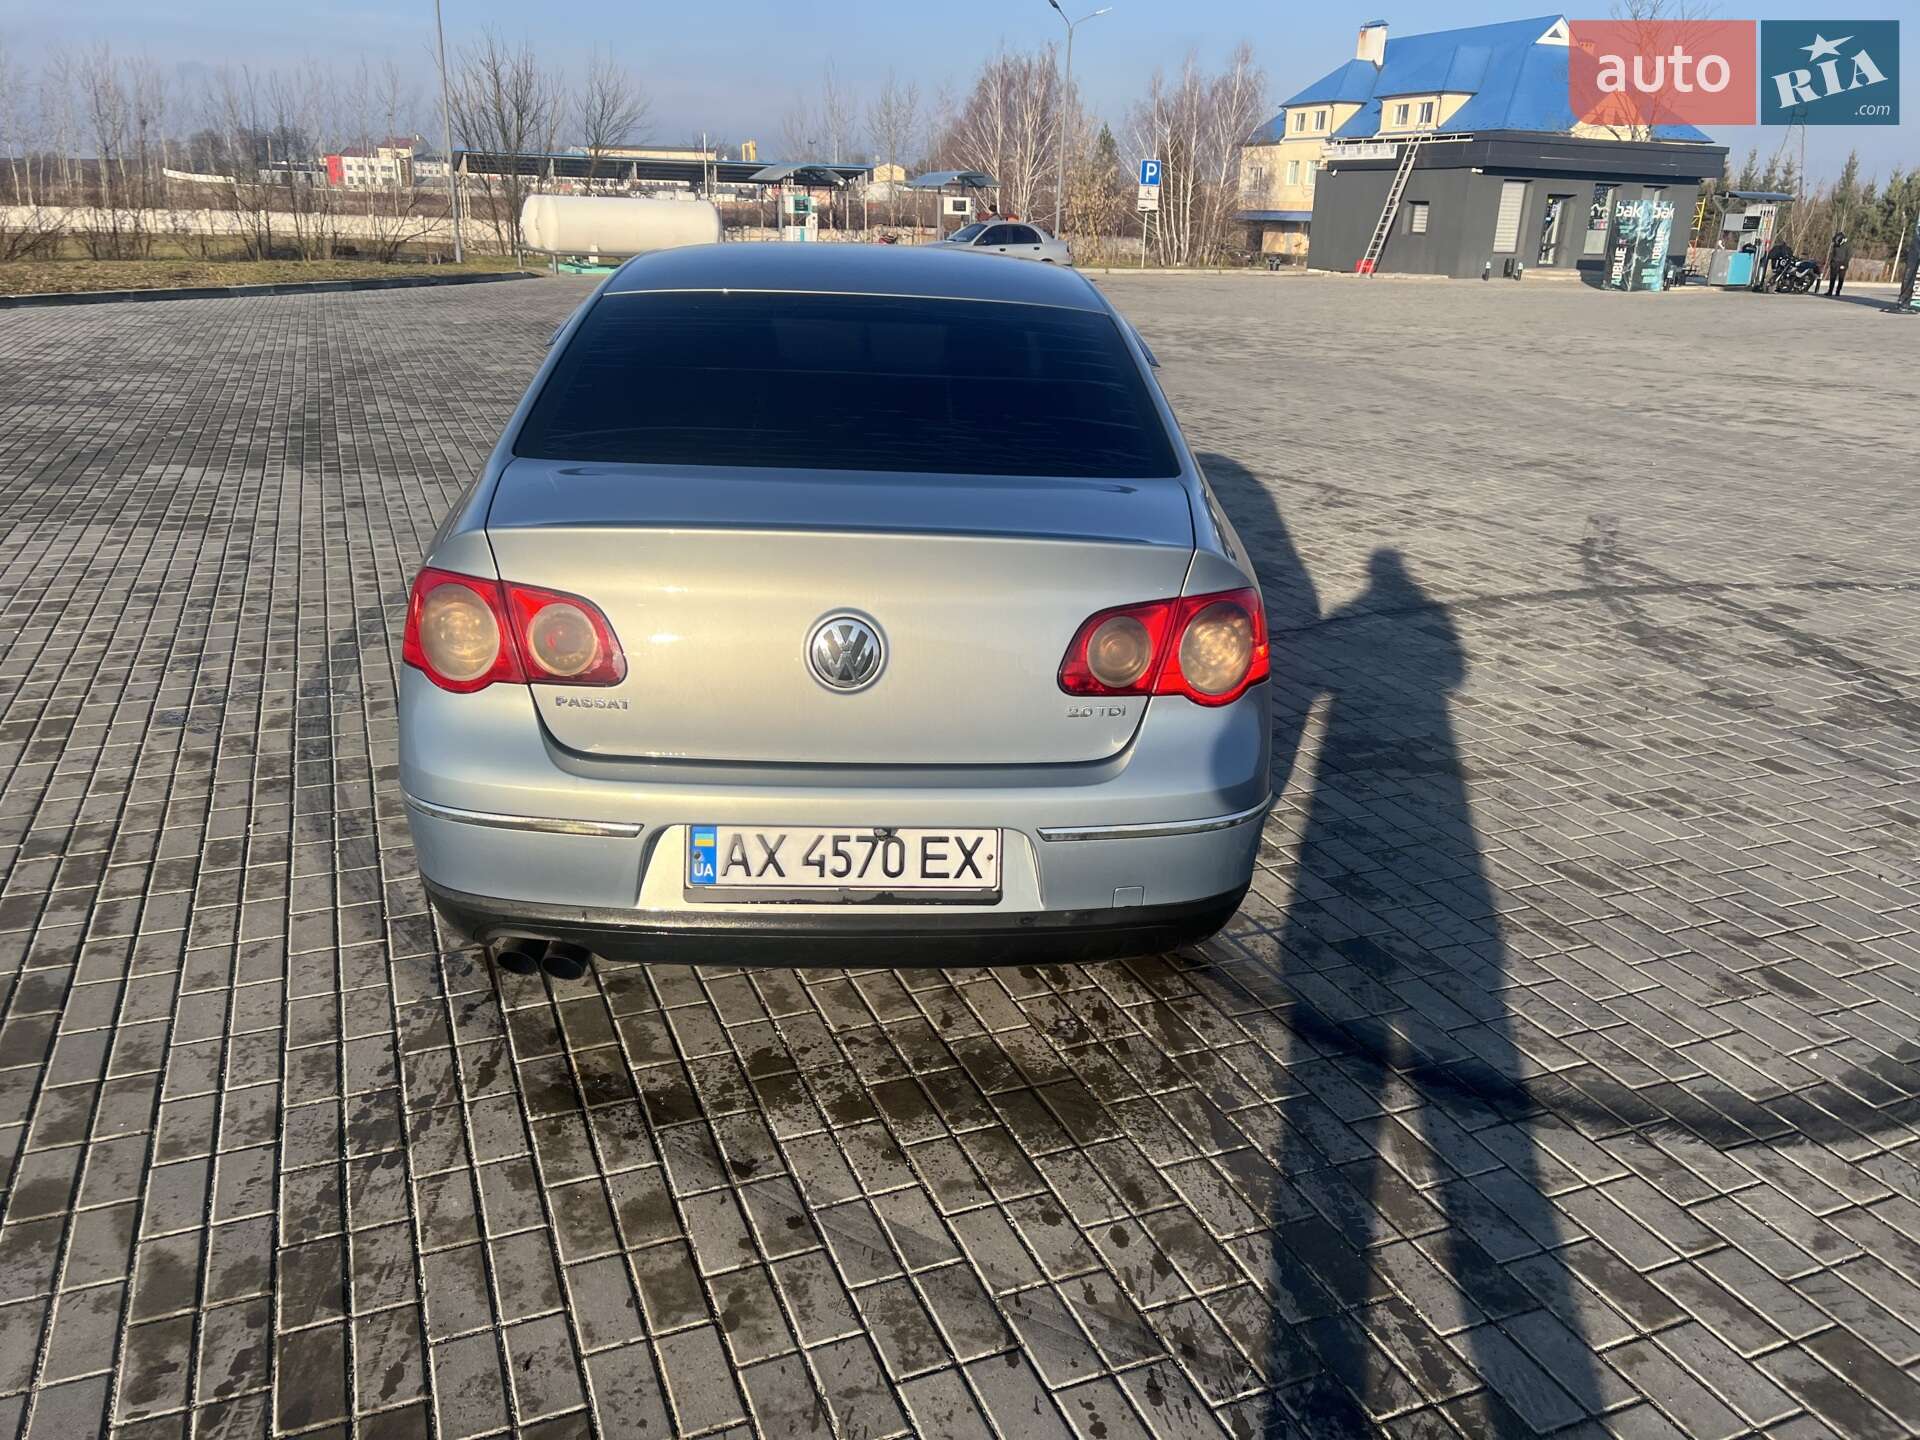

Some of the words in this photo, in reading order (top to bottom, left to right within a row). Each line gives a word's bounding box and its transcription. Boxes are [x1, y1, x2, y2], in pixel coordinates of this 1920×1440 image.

[1145, 162, 1158, 183] P
[1611, 246, 1627, 286] ADBLUE
[555, 696, 630, 710] PASSAT
[1096, 705, 1126, 717] TDI
[721, 833, 787, 877] AX
[802, 834, 905, 878] 4570
[920, 836, 983, 879] EX
[694, 863, 713, 877] UA
